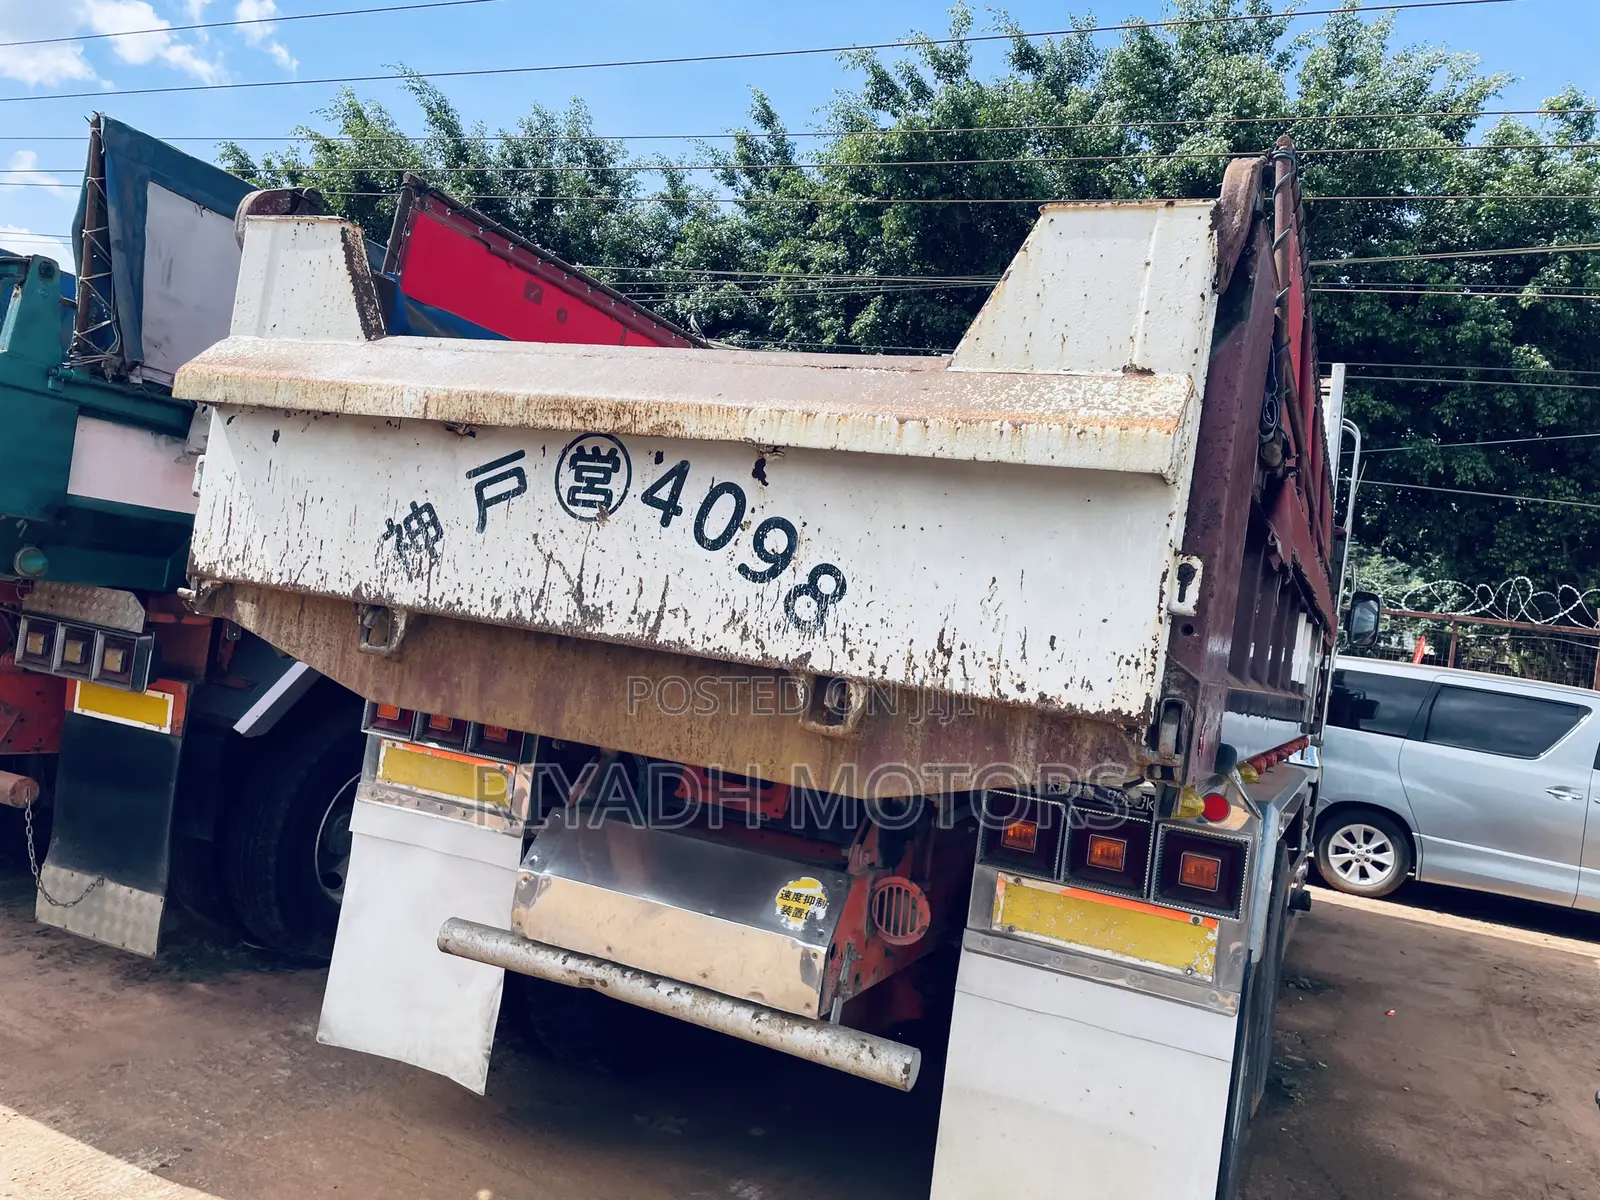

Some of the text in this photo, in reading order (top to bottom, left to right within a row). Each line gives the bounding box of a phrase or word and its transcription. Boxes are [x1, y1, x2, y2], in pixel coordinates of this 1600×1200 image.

[641, 459, 847, 631] 4098
[779, 889, 827, 908] 速度抑制
